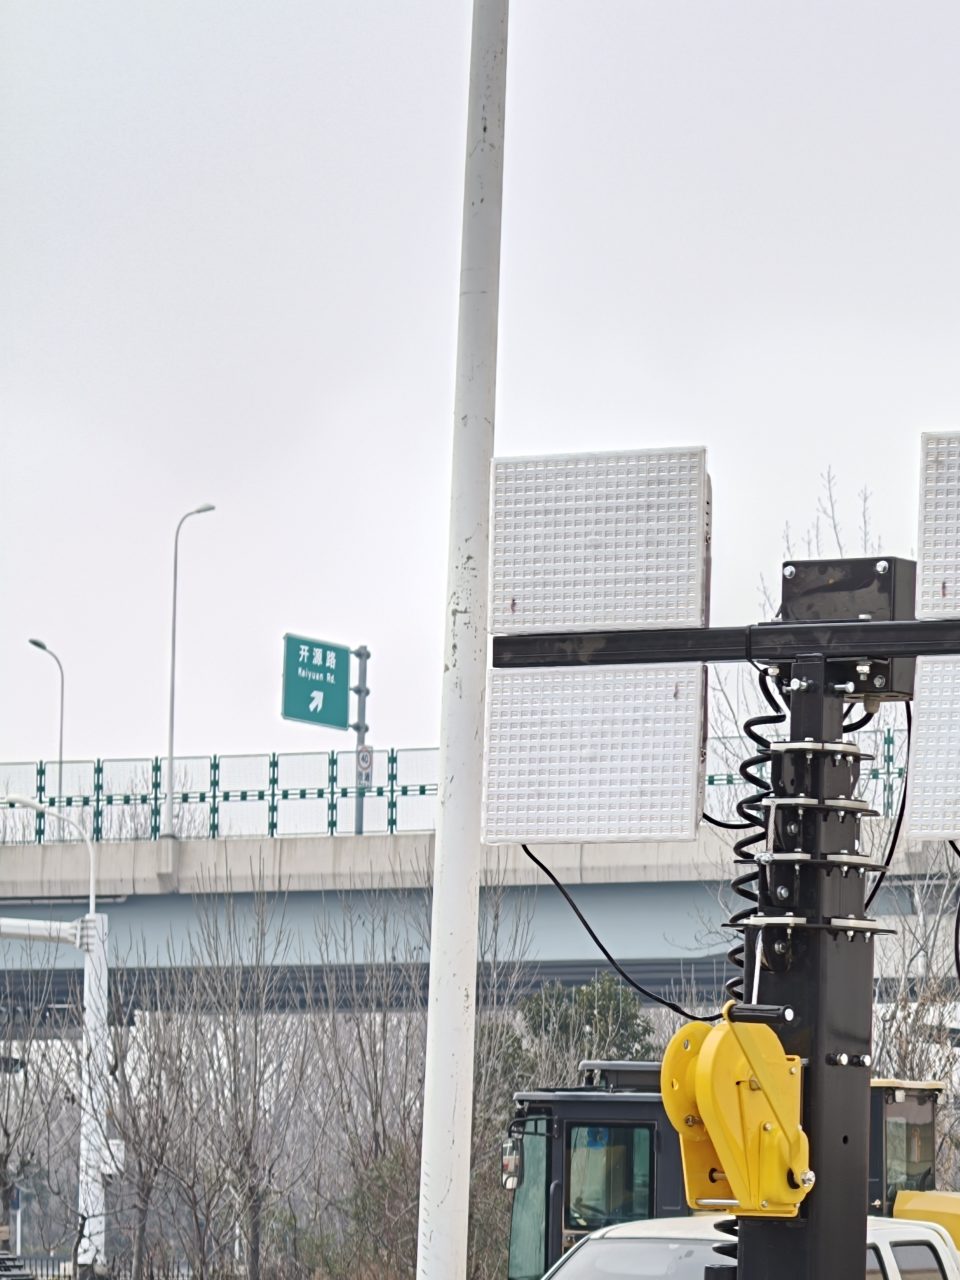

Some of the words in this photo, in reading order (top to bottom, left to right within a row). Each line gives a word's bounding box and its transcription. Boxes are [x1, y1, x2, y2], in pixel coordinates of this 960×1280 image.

[299, 644, 336, 669] 开源路
[298, 667, 324, 681] Kaiyuan
